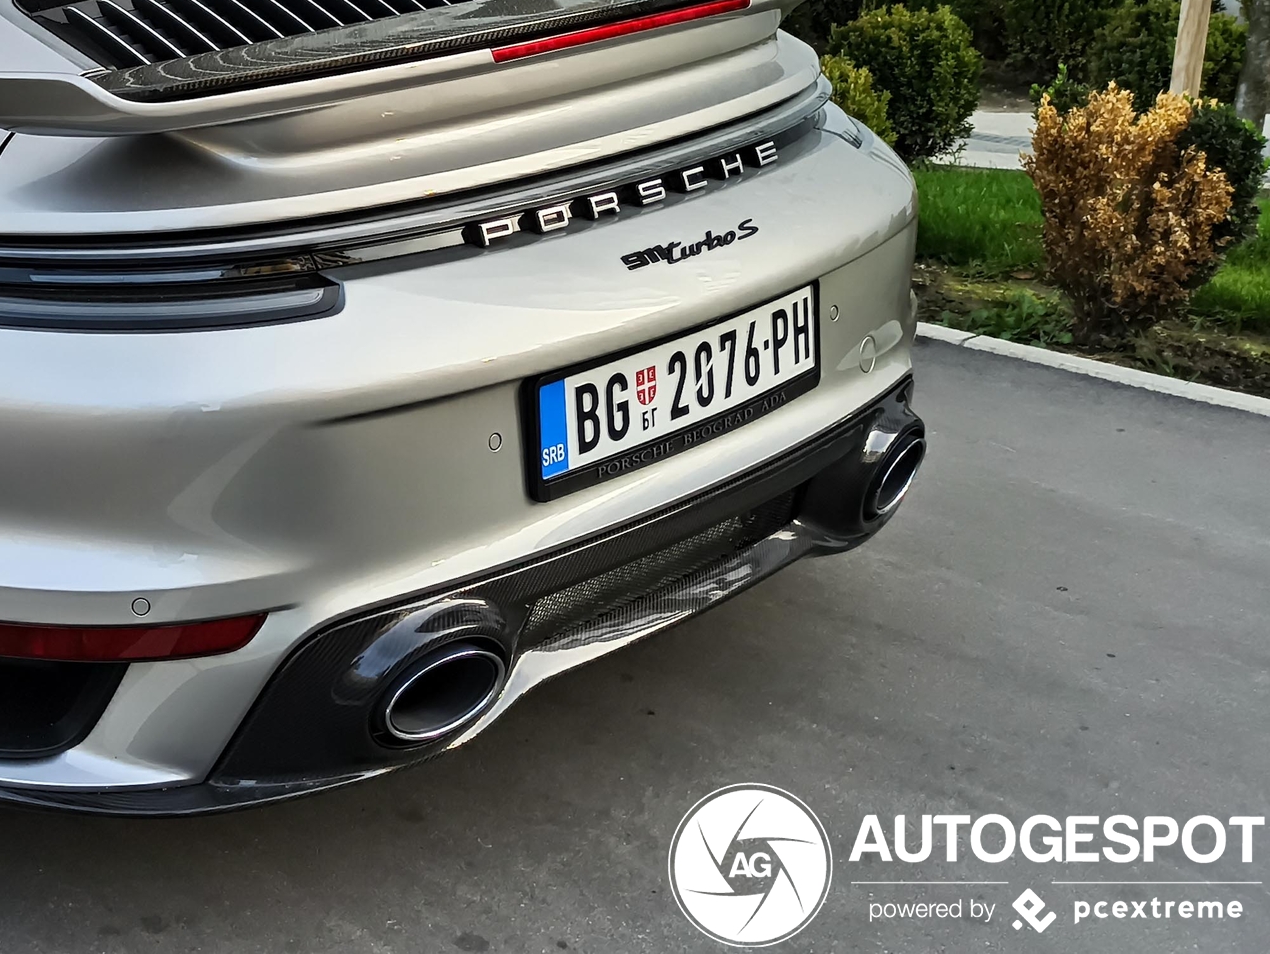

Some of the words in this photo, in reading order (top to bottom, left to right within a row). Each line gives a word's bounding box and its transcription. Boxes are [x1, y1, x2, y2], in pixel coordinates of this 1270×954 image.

[479, 140, 779, 246] PORSCHE
[542, 443, 565, 467] SRB
[574, 372, 630, 455] BG
[597, 440, 675, 479] PORSCHE
[683, 407, 754, 446] BEOGRAD
[761, 391, 788, 412] ADA
